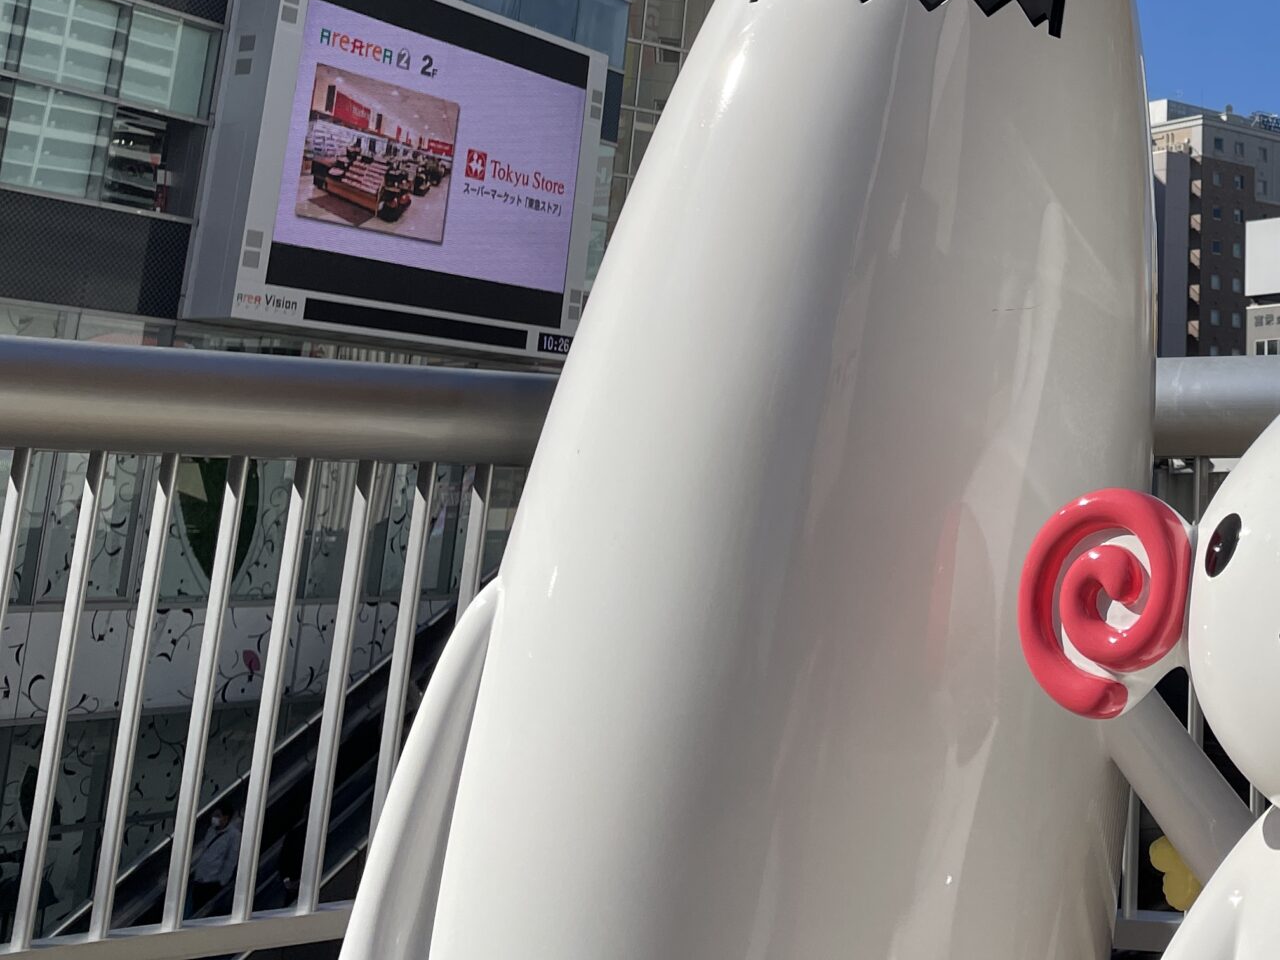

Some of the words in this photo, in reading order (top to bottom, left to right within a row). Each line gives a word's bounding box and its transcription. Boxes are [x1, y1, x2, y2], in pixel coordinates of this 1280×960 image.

[491, 159, 529, 187] Tokyu
[532, 171, 564, 195] Store
[265, 293, 298, 311] Vision
[543, 335, 570, 353] 10:26
